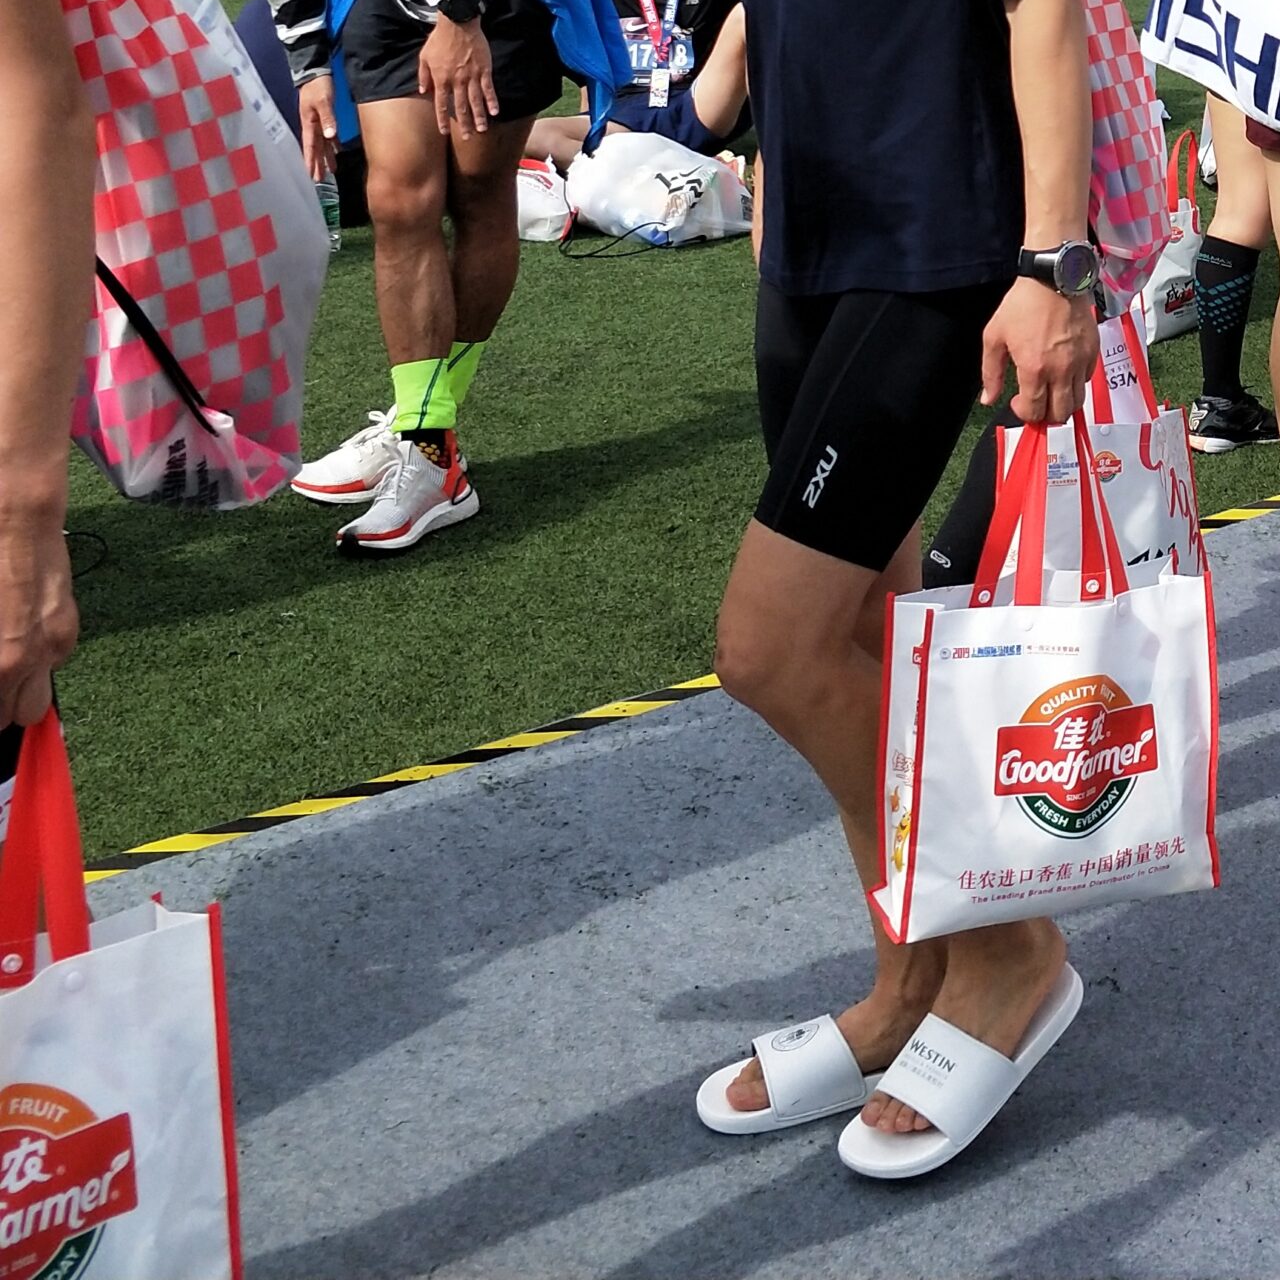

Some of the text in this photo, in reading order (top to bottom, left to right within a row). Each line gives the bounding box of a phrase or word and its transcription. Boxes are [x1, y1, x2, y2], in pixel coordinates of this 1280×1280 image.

[802, 444, 838, 509] 2XU
[1040, 684, 1098, 715] QUALITY
[999, 738, 1148, 791] Goodfarmer
[1034, 786, 1120, 829] FRESH EVERYDAY
[958, 836, 1186, 891] 佳农进口香蕉 中国销量领先
[972, 895, 988, 904] The
[991, 890, 1025, 902] Leading
[1028, 886, 1054, 897] Brand
[1056, 882, 1087, 893] Banana
[1089, 872, 1135, 888] Distributor
[1147, 864, 1171, 875] China
[910, 1037, 957, 1073] WESTIN
[8, 1097, 69, 1123] FRUIT
[0, 1137, 52, 1194] 农
[0, 1169, 115, 1249] armer
